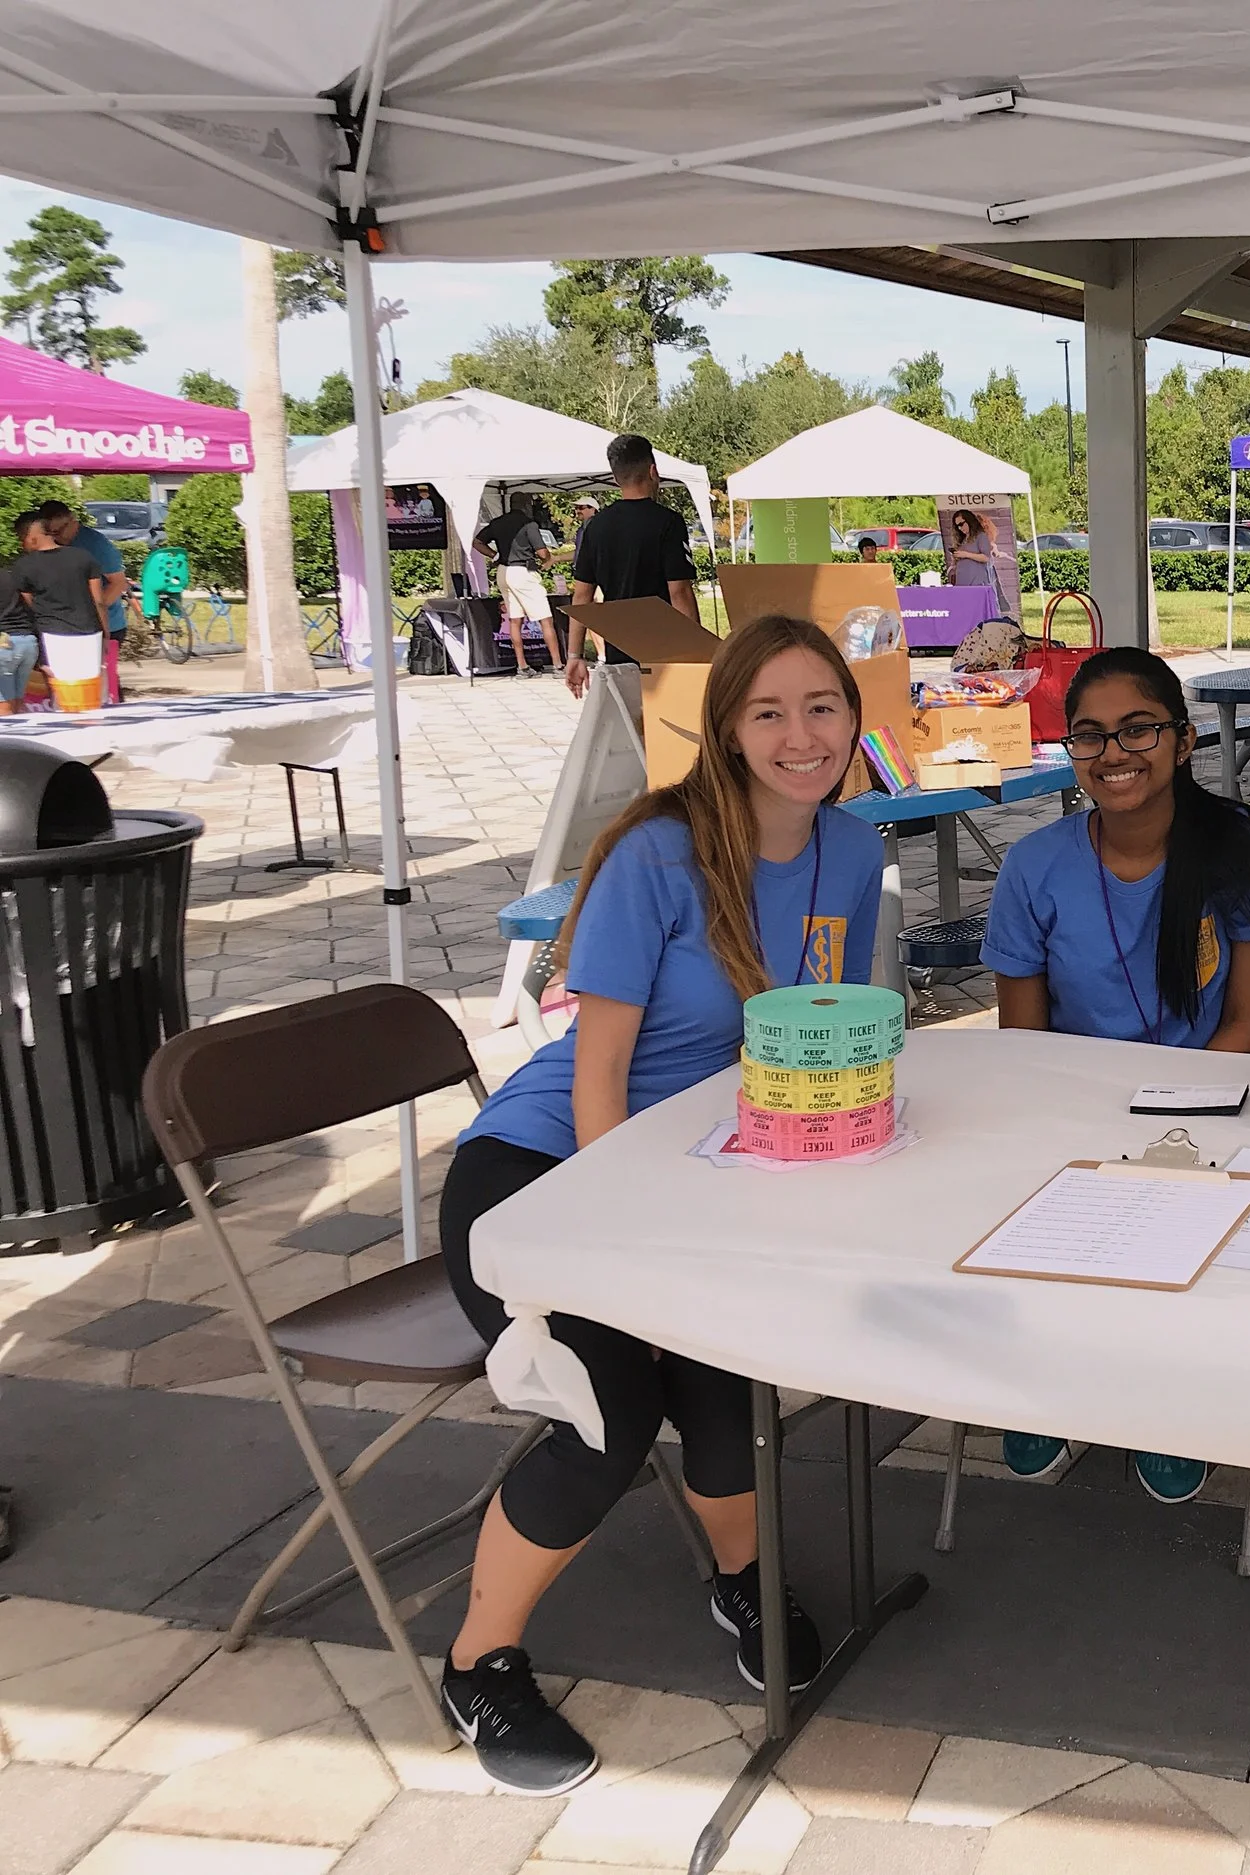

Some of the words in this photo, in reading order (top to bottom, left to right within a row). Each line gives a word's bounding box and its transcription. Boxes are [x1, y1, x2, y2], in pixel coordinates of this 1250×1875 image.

[24, 414, 206, 462] Smoothie
[948, 493, 995, 505] sitters
[759, 1024, 782, 1038] TICKET
[798, 1029, 831, 1040] TICKET
[848, 1024, 876, 1037] TICKET
[763, 1044, 779, 1052] KEEP
[853, 1044, 873, 1053] KEEP
[759, 1053, 784, 1064] COUPON
[847, 1053, 878, 1064] COUPON
[856, 1063, 880, 1078] TICKET
[764, 1070, 791, 1083] TICKET
[808, 1072, 839, 1083] TICKET
[860, 1084, 877, 1093] KEEP
[856, 1092, 881, 1104] COUPON
[764, 1100, 793, 1109] COUPON
[808, 1101, 841, 1109] COUPON
[849, 1107, 876, 1118] COUPON
[801, 1115, 835, 1123] COUPON
[854, 1118, 872, 1127] KEEP
[751, 1136, 775, 1151] TICKET
[850, 1132, 876, 1148] TICKET
[802, 1141, 835, 1152] TICKET
